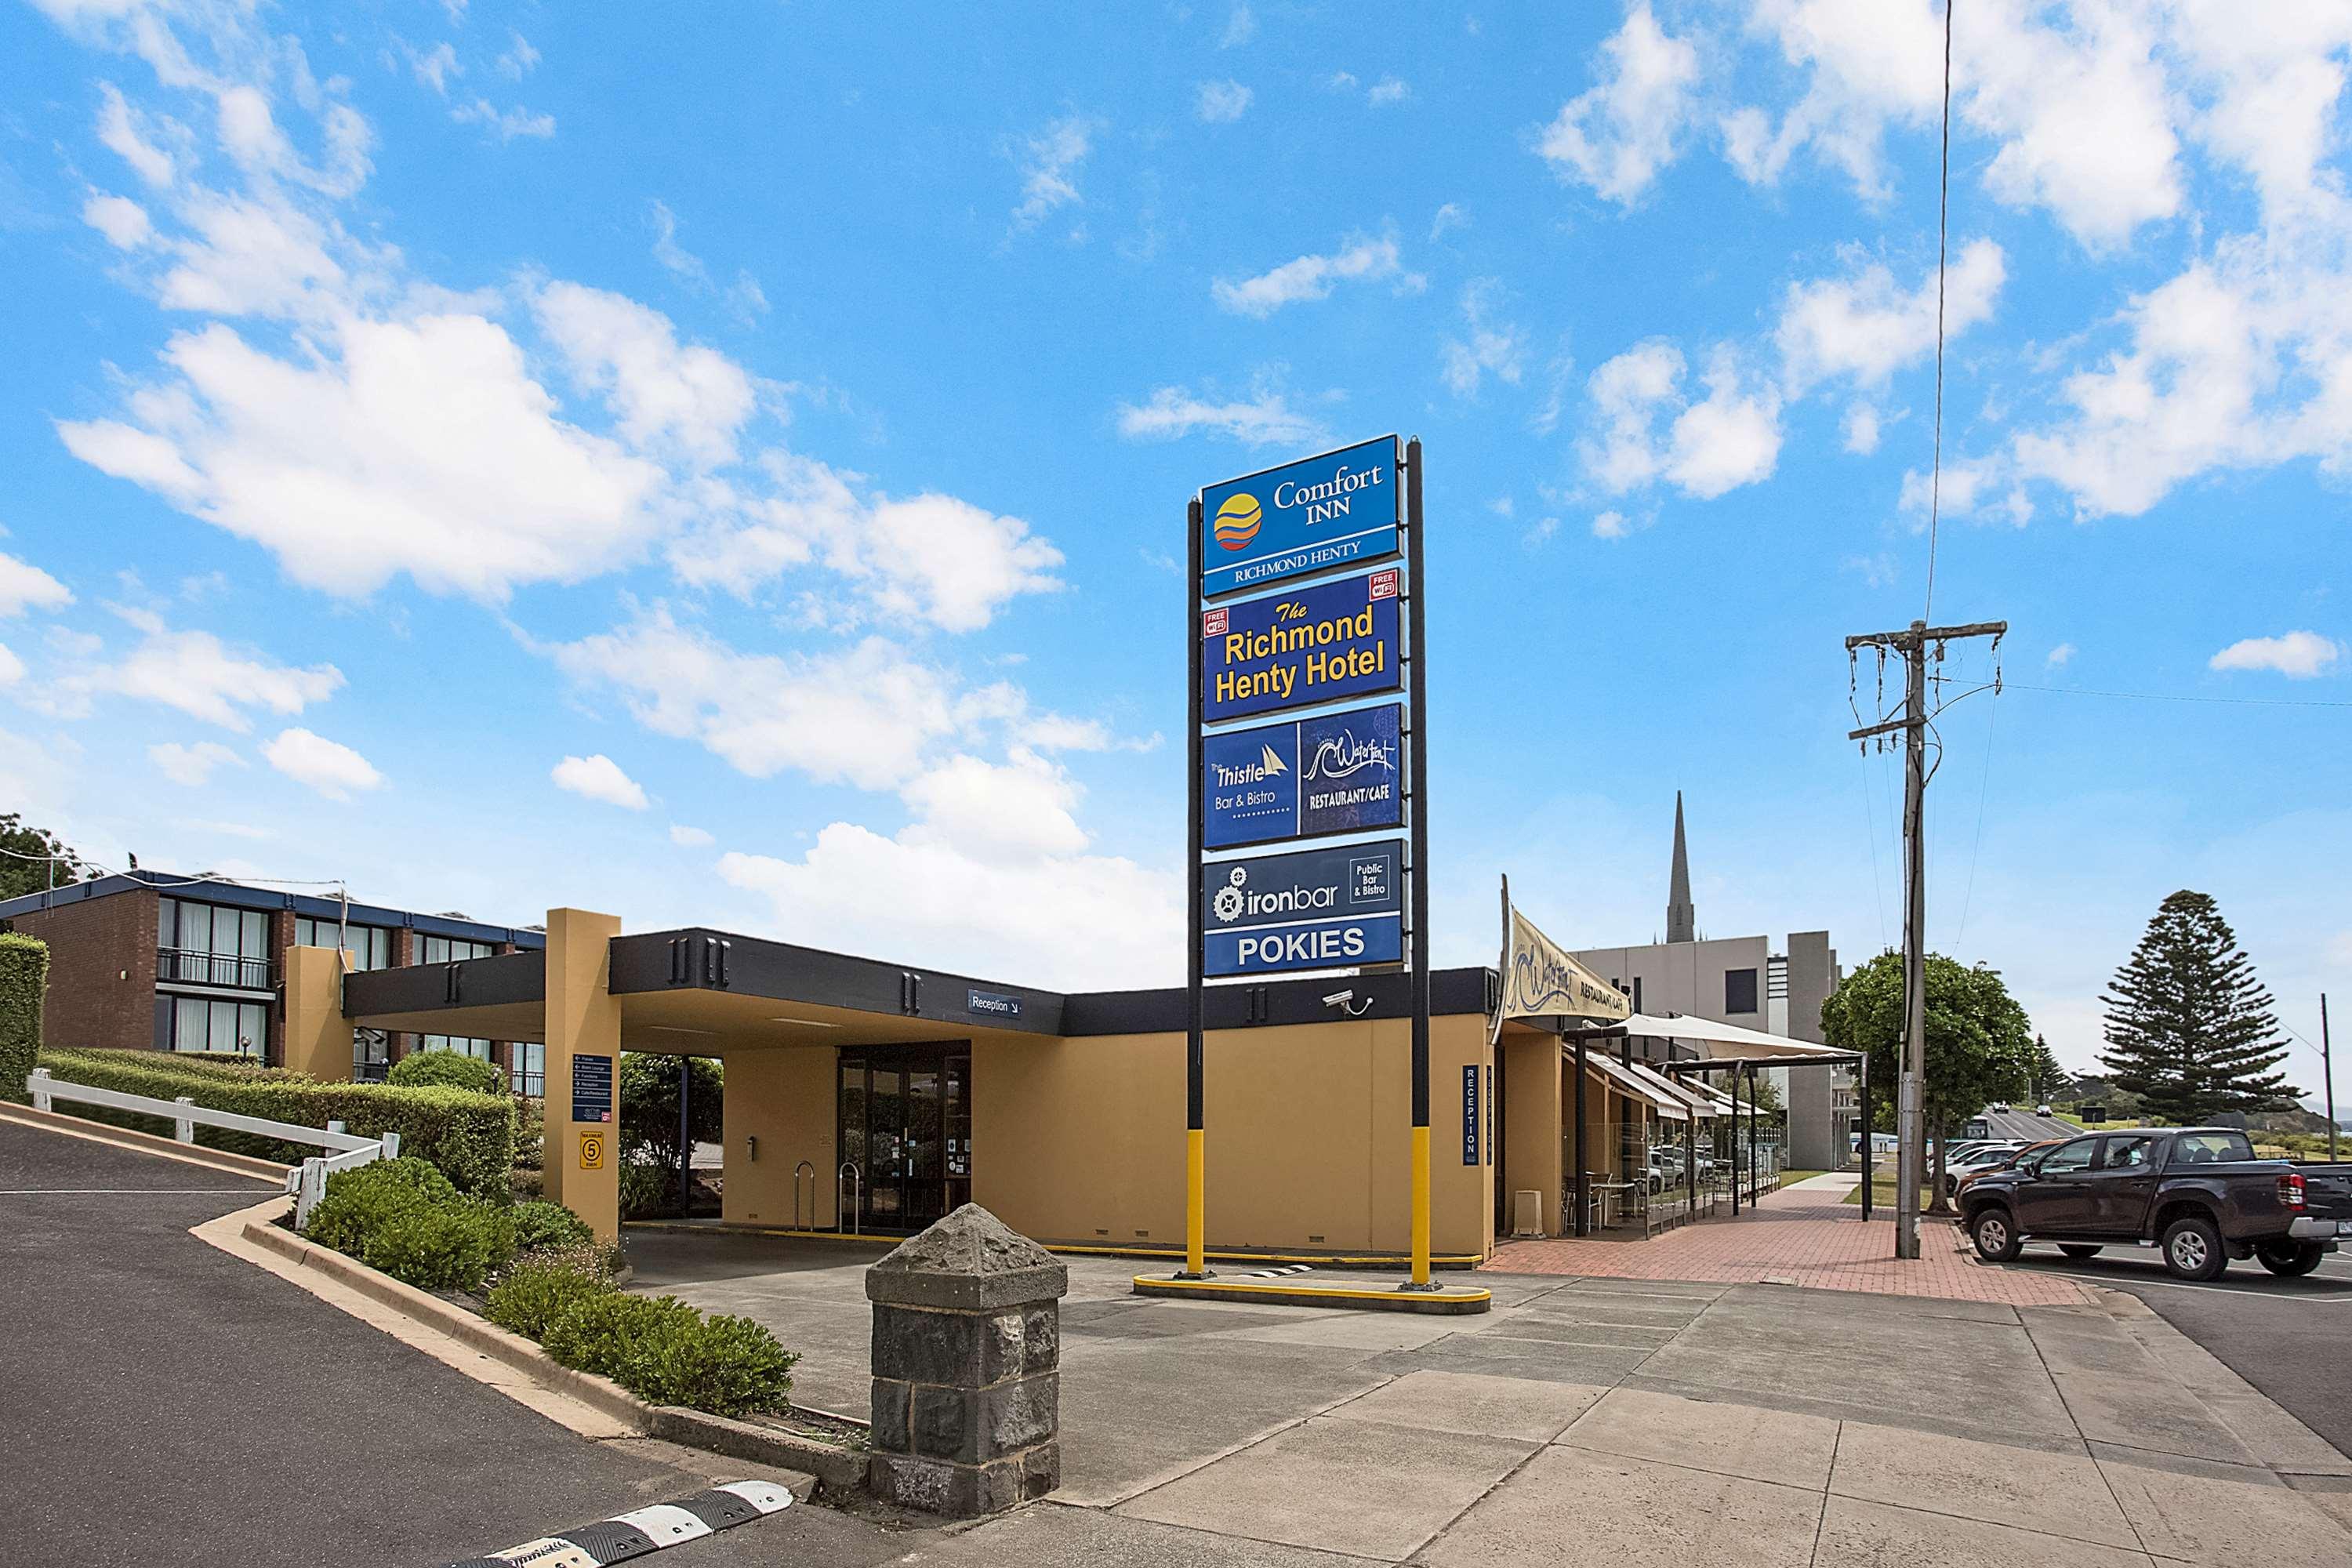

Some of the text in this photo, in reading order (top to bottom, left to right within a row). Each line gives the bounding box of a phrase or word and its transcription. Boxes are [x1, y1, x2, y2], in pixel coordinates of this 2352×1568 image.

[1274, 466, 1384, 509] Comfort
[1305, 496, 1351, 526] INN
[1235, 541, 1361, 583] RICHMOND HENTY
[1373, 573, 1393, 585] FREE
[1208, 612, 1225, 622] FREE
[1276, 601, 1308, 622] The
[1225, 604, 1373, 665] Richmond
[1216, 641, 1384, 703] Henty Hotel
[1218, 763, 1265, 787] Thistle
[1215, 791, 1276, 810] Bar & Bistro
[1309, 784, 1390, 810] RESTAURANT/CAFE
[1356, 862, 1383, 876] Public
[1354, 884, 1385, 897] & Bistro
[1363, 876, 1377, 885] Bar
[1247, 884, 1338, 915] ironbar
[1238, 927, 1365, 966] POKIES
[972, 996, 1008, 1012] Reception
[588, 1143, 596, 1157] 5
